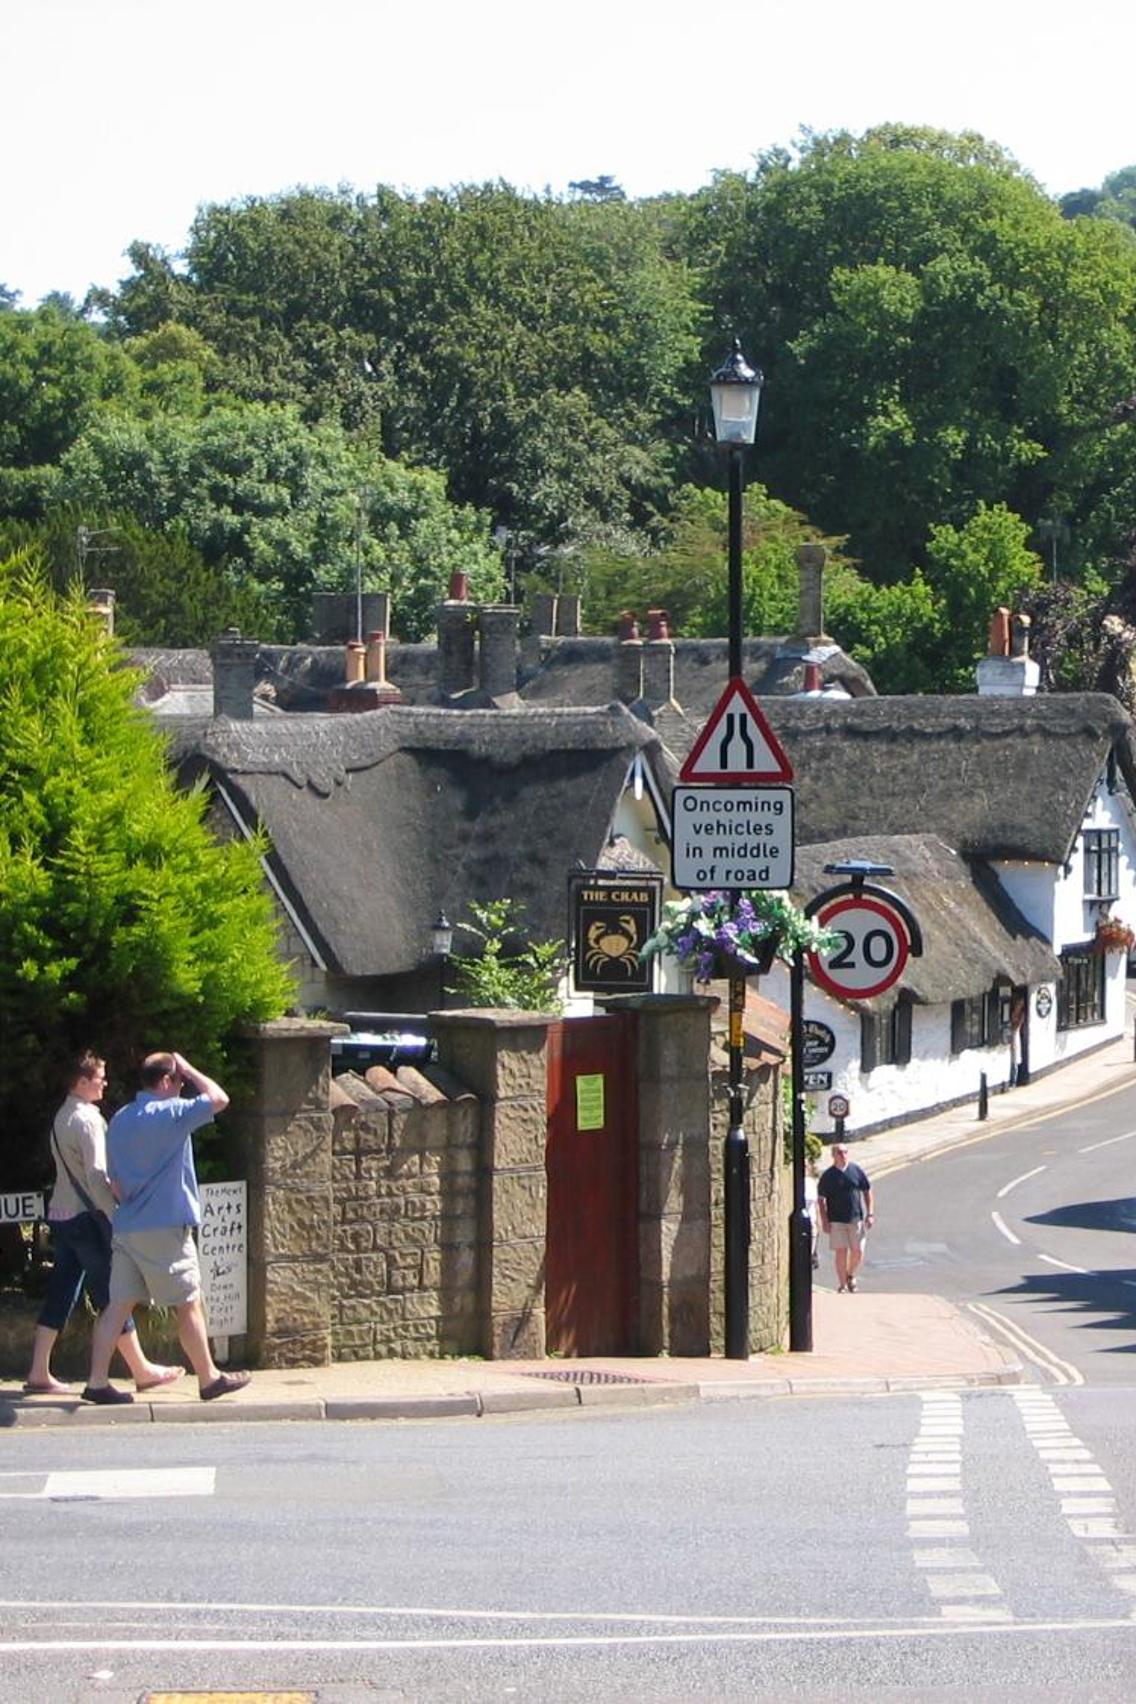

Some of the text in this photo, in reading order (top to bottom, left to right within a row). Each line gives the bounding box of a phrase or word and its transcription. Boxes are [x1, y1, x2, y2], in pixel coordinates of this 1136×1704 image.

[683, 795, 784, 816] Oncoming
[692, 819, 774, 836] vehicles
[686, 842, 780, 858] in middle
[696, 865, 770, 882] of road
[582, 890, 649, 902] THE CRAB
[828, 928, 895, 970] 20
[0, 1195, 35, 1219] UE
[204, 1202, 242, 1217] Arts
[202, 1221, 242, 1238] Craft
[202, 1243, 244, 1256] Centre
